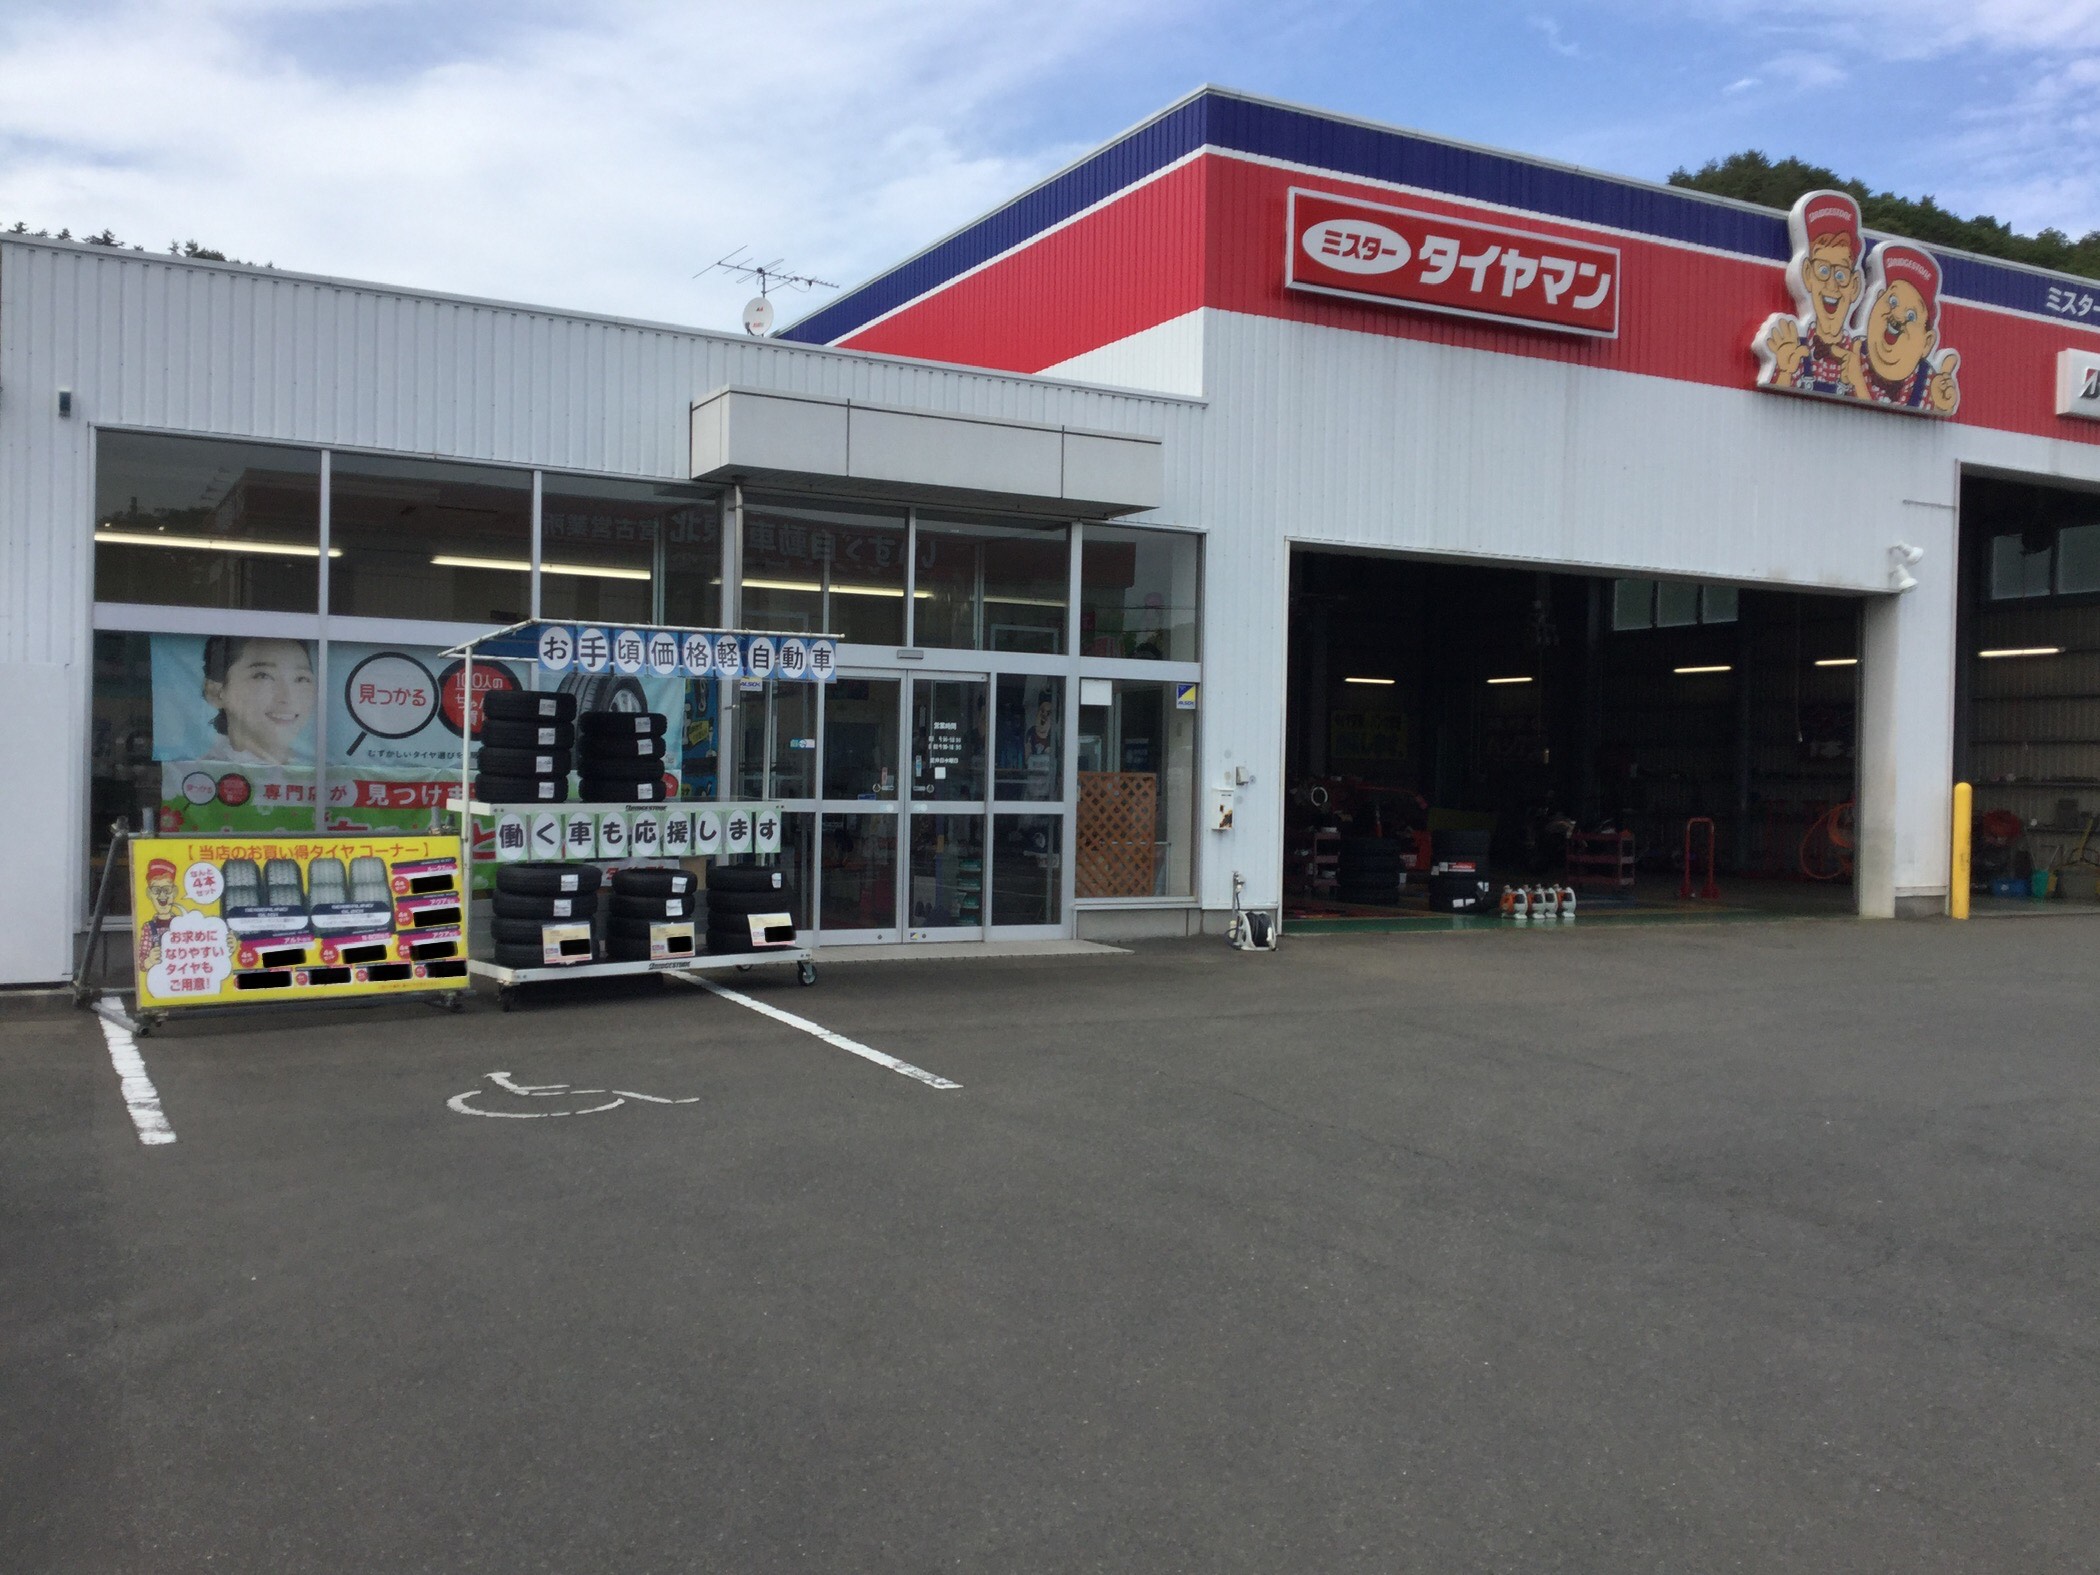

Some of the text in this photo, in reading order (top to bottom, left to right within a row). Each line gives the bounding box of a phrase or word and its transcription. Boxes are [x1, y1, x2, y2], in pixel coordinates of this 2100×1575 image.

[1321, 229, 1611, 309] ミスター タイヤマン
[542, 634, 832, 671] お手頃価格軽自動車
[359, 684, 427, 706] 見つかる
[500, 818, 777, 849] 働く車も応援します
[192, 876, 216, 888] 4本
[170, 930, 217, 943] お求めに
[165, 946, 224, 960] なりやすい
[165, 962, 213, 975] タイヤも
